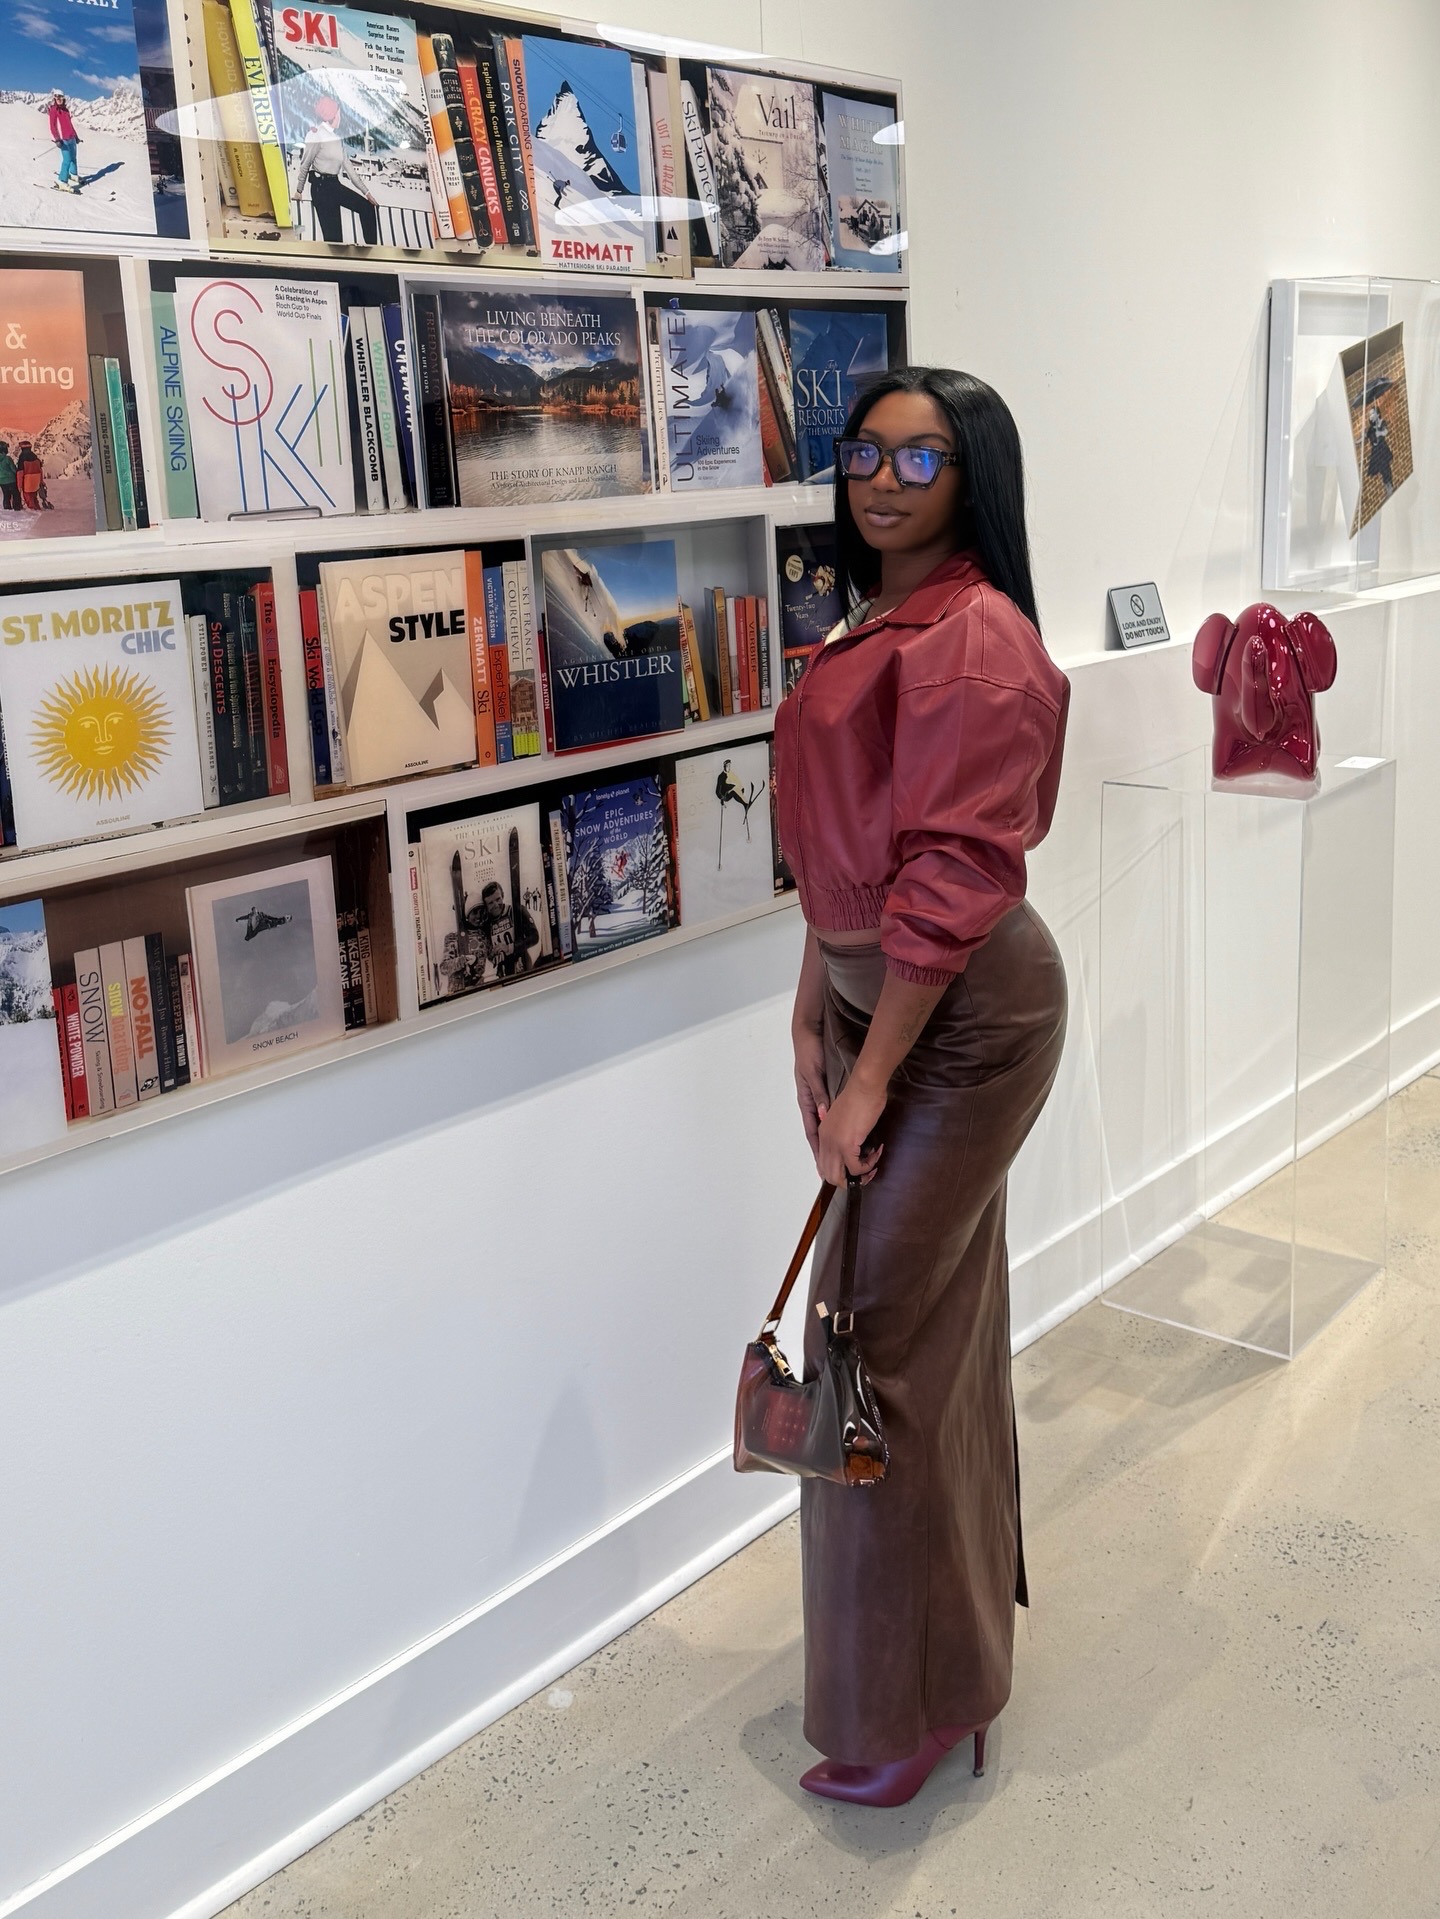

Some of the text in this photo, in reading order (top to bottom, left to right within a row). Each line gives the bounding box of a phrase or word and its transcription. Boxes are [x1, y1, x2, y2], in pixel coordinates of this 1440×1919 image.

[282, 8, 339, 48] SKI
[366, 21, 400, 33] American Racers
[367, 30, 400, 42] Surprise Europe
[364, 42, 374, 50] Pick
[384, 45, 394, 53] Best
[395, 47, 405, 55] Time
[216, 21, 231, 56] HOW
[225, 60, 237, 82] DID
[243, 143, 260, 189] BEGIN?
[244, 56, 280, 147] EVEREST
[513, 58, 532, 150] SNOWBOARDING
[756, 94, 797, 129] Vail
[482, 62, 514, 212] Exploring the Coast Mountains On Skis
[501, 82, 524, 174] PARK CITY
[656, 117, 670, 139] LOST
[465, 78, 500, 214] THE CRAZY CANUCKS
[662, 144, 673, 159] SKI
[840, 136, 884, 155] MAGIC
[682, 101, 718, 223] Ski Pioneers
[551, 239, 634, 263] ZERMATT
[559, 262, 595, 270] MATTERHORN
[280, 286, 312, 295] Celebration
[286, 295, 305, 304] Racing
[295, 312, 305, 320] Cup
[306, 313, 322, 321] Finals
[486, 311, 601, 328] LIVING BENEATH
[5, 323, 27, 350] &
[465, 328, 622, 346] THE COLORADO PEAKS
[0, 358, 74, 390] rding
[425, 311, 443, 427] FREEDOM FOUND
[653, 350, 664, 395] Preferred
[160, 325, 188, 471] ALPINE SKIING
[372, 341, 395, 449] Whistler Bowl
[667, 317, 694, 482] ULTIMATE
[796, 368, 844, 408] SKI
[355, 338, 379, 482] WHISTLER BLACKCOMB
[798, 409, 845, 426] RESORTS
[696, 435, 720, 447] Skiing
[808, 427, 820, 436] THE
[697, 446, 740, 456] Adventures
[490, 464, 617, 480] THE STORY OF KNAPP RANCH
[333, 567, 462, 622] ASPEN
[487, 577, 496, 639] VICTORY SEASON
[785, 602, 816, 613] Twenty-Two
[2, 600, 175, 646] ST. MORITZ
[389, 609, 465, 643] STYLE
[507, 580, 520, 663] COURCHEVEL
[522, 586, 534, 663] SKI FRANCE
[718, 605, 727, 644] Passion
[795, 611, 809, 620] Years
[1122, 616, 1161, 631] LOOK AND ENJOY
[121, 629, 176, 655] CHIC
[198, 623, 207, 673] STILLPOWER
[226, 632, 235, 643] The
[749, 621, 757, 673] VERBIER
[1125, 626, 1165, 641] DO NOT TOUCH
[211, 621, 226, 715] SKI DESCENTS
[229, 666, 238, 679] New
[264, 601, 280, 739] The Encyclopedia
[473, 617, 491, 716] ZERMATT Ski
[494, 649, 505, 688] Expert
[557, 654, 675, 689] WHISTLER
[305, 637, 326, 736] Ski World Cup
[497, 691, 507, 719] Skier
[405, 760, 428, 768] ASSOULINE
[596, 788, 630, 800] lonely planet
[96, 814, 131, 826] ASSOULINE
[575, 810, 654, 837] SNOW ADVENTURES
[605, 807, 624, 820] EPIC
[464, 834, 501, 860] SKI
[603, 832, 628, 844] WORLD
[474, 859, 494, 868] BOOK
[359, 935, 370, 959] KING
[348, 942, 362, 988] KEANE
[130, 975, 154, 1060] NO-FALL
[170, 965, 186, 1067] THE KEEPER HOWARD
[67, 1012, 84, 1078] WHITE POWDER
[80, 971, 106, 1110] SNOW Snowboarding
[252, 1031, 299, 1051] SNOW BEACH
